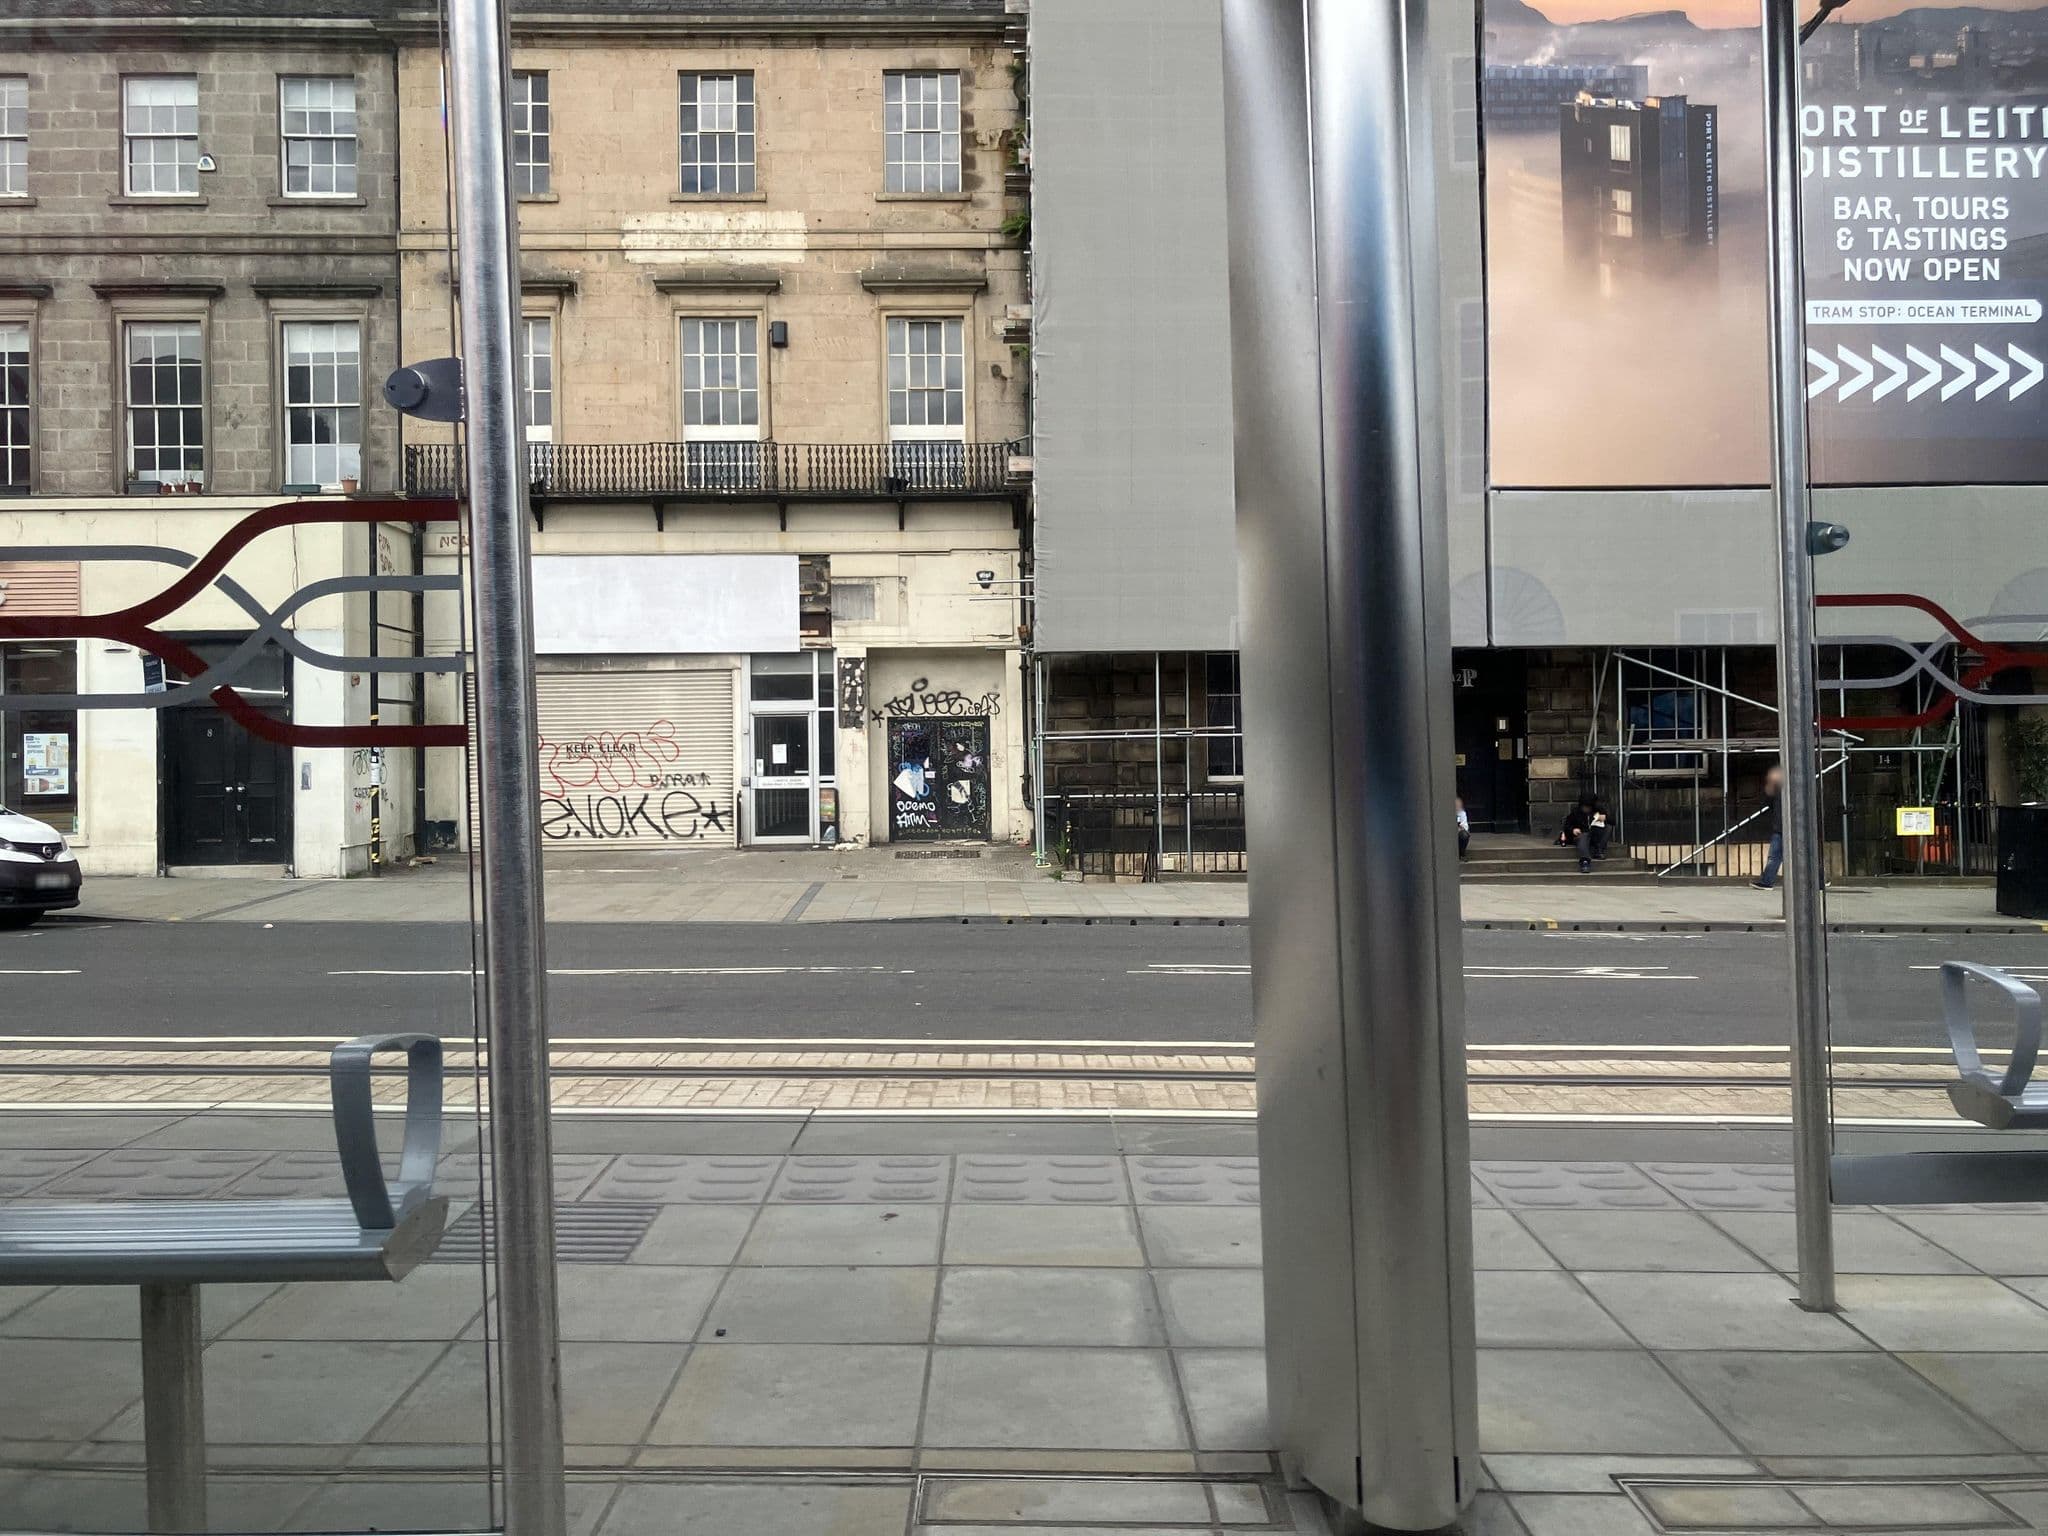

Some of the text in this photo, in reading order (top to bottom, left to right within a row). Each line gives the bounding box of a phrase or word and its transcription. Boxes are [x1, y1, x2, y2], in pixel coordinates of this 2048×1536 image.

[1801, 105, 2048, 139] ORT OF LEIT
[1705, 151, 1713, 182] LEITH
[1834, 197, 2009, 224] BAR, TOURS
[1836, 227, 2008, 251] & TASTINGS
[1844, 257, 2001, 281] NOW OPEN
[1813, 305, 2032, 318] TRAM STOP: OCEAN TERMINAL
[207, 729, 213, 738] 8
[566, 742, 636, 754] KEEP CLEAR
[1879, 754, 1890, 764] 14
